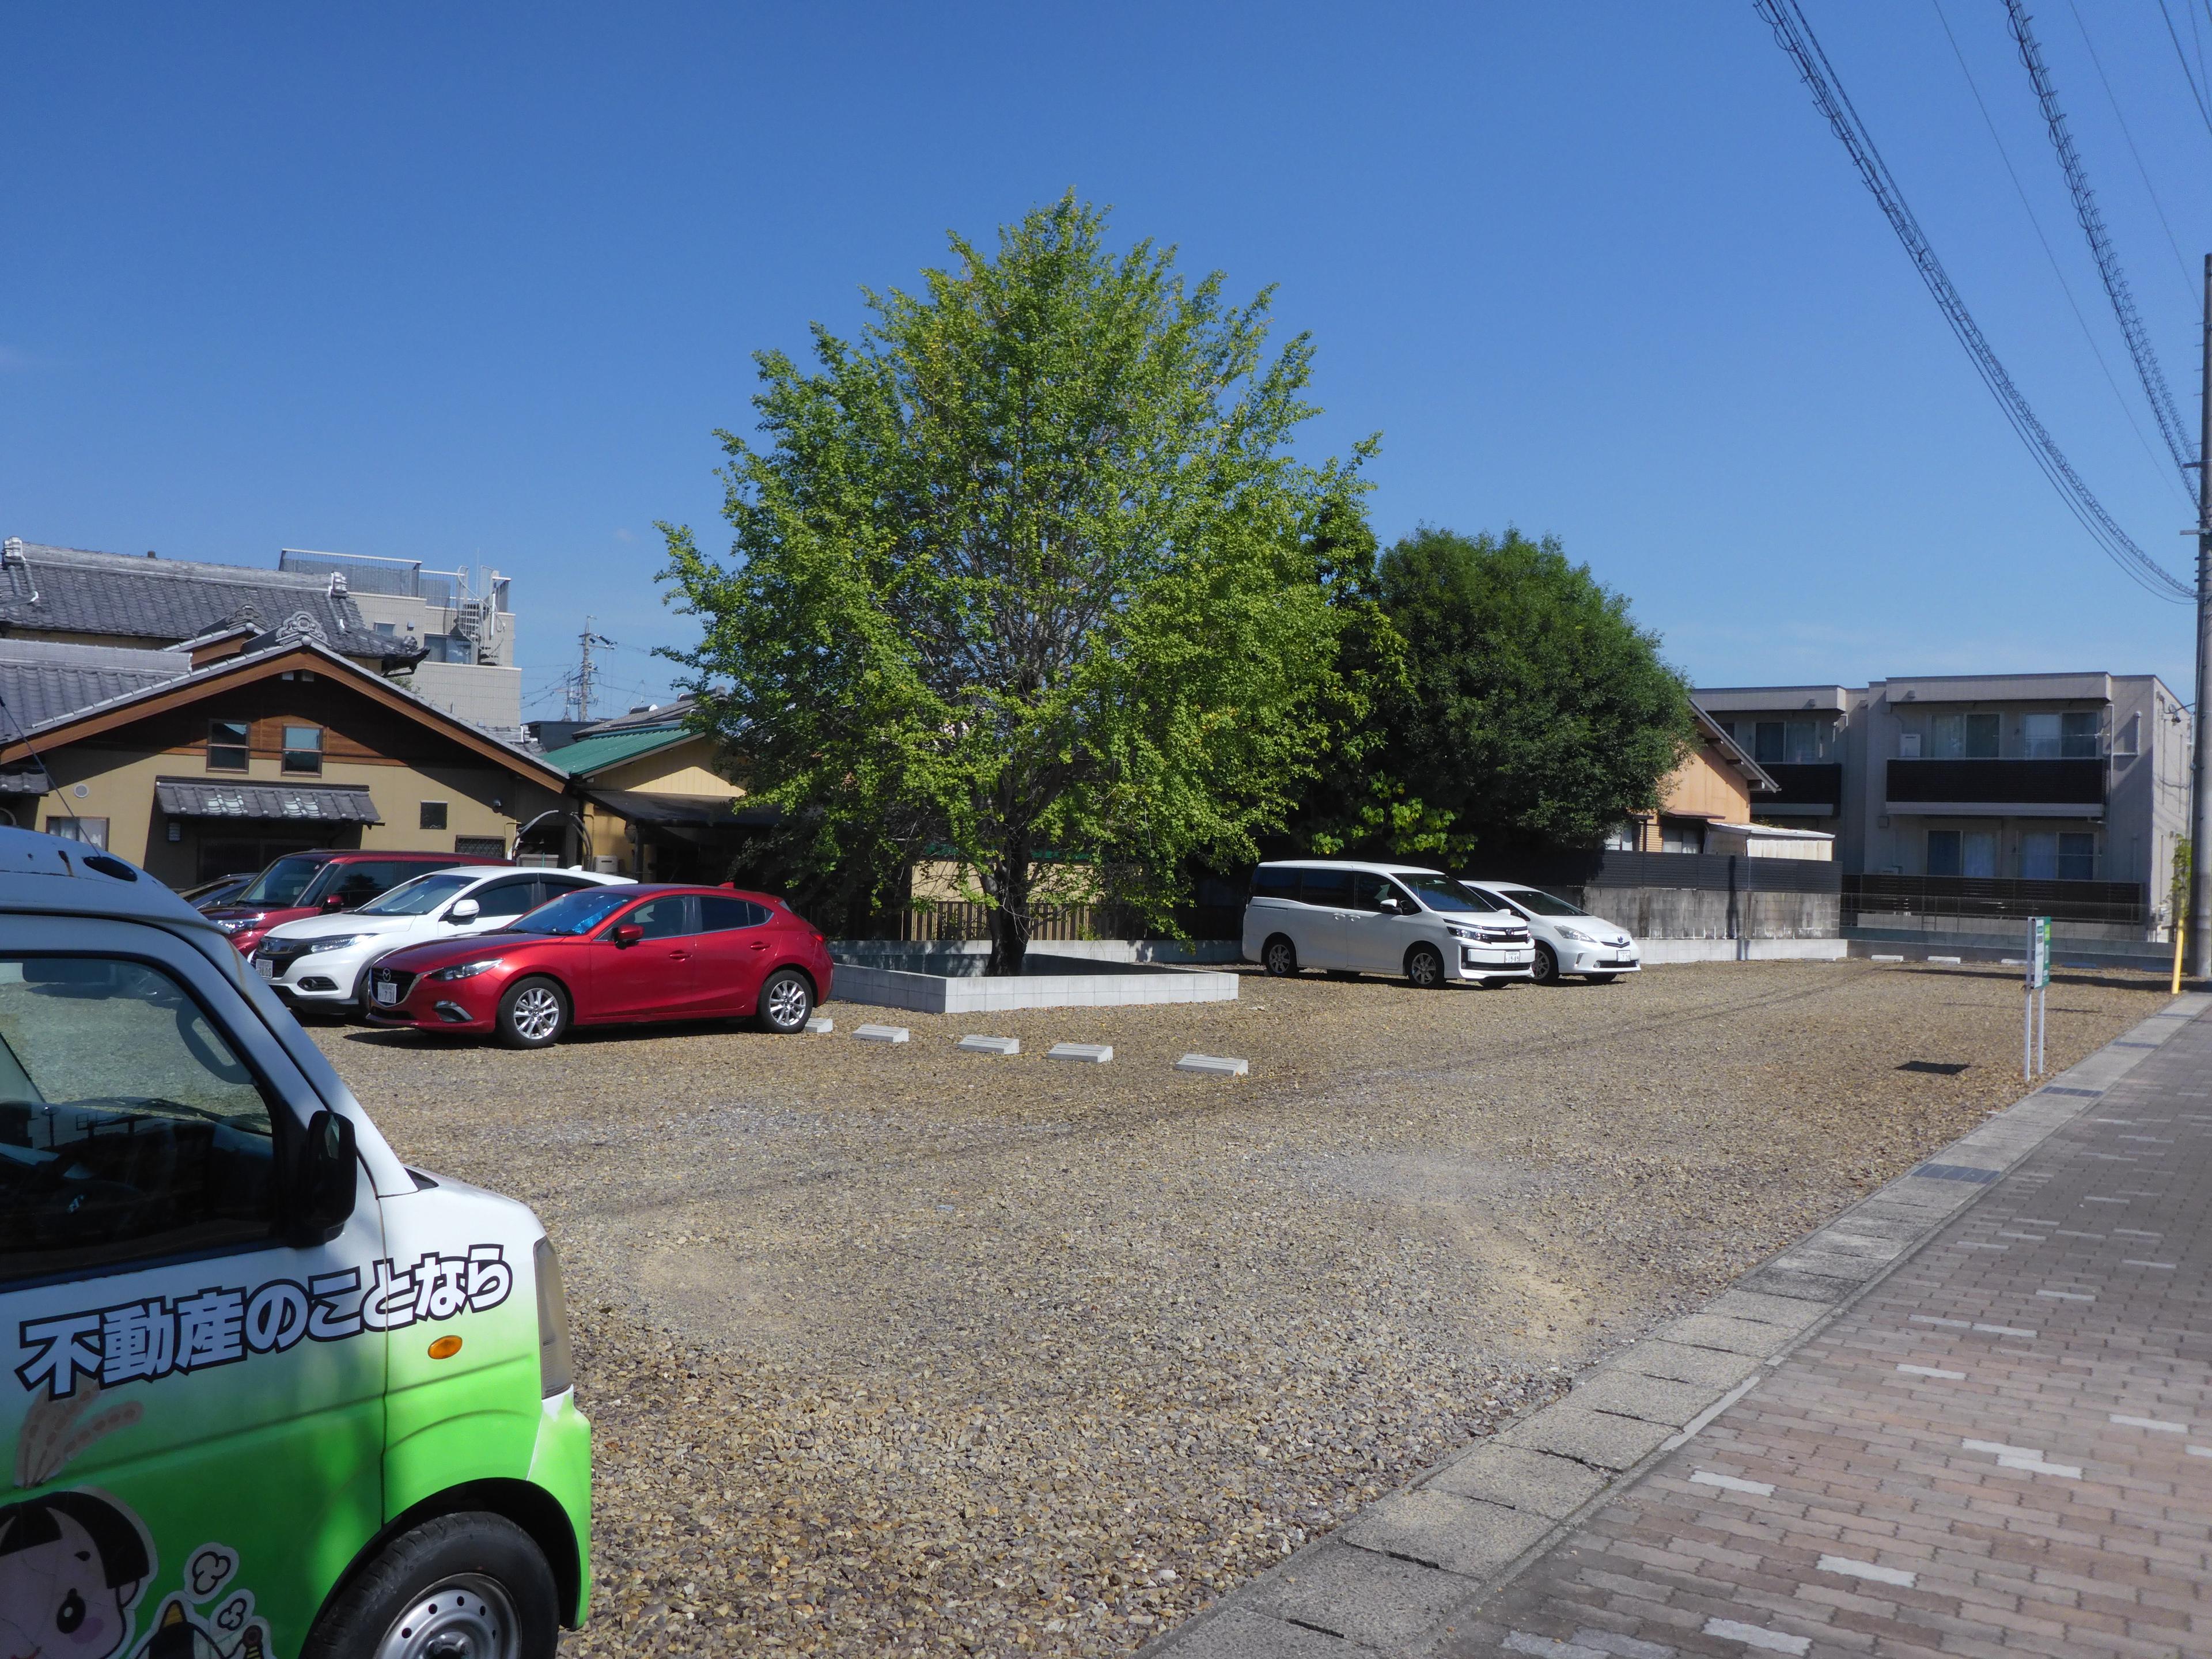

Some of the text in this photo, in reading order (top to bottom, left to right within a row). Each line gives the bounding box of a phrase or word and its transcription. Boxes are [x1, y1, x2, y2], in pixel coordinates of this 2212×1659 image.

[14, 1244, 513, 1400] 不動産のことなら
